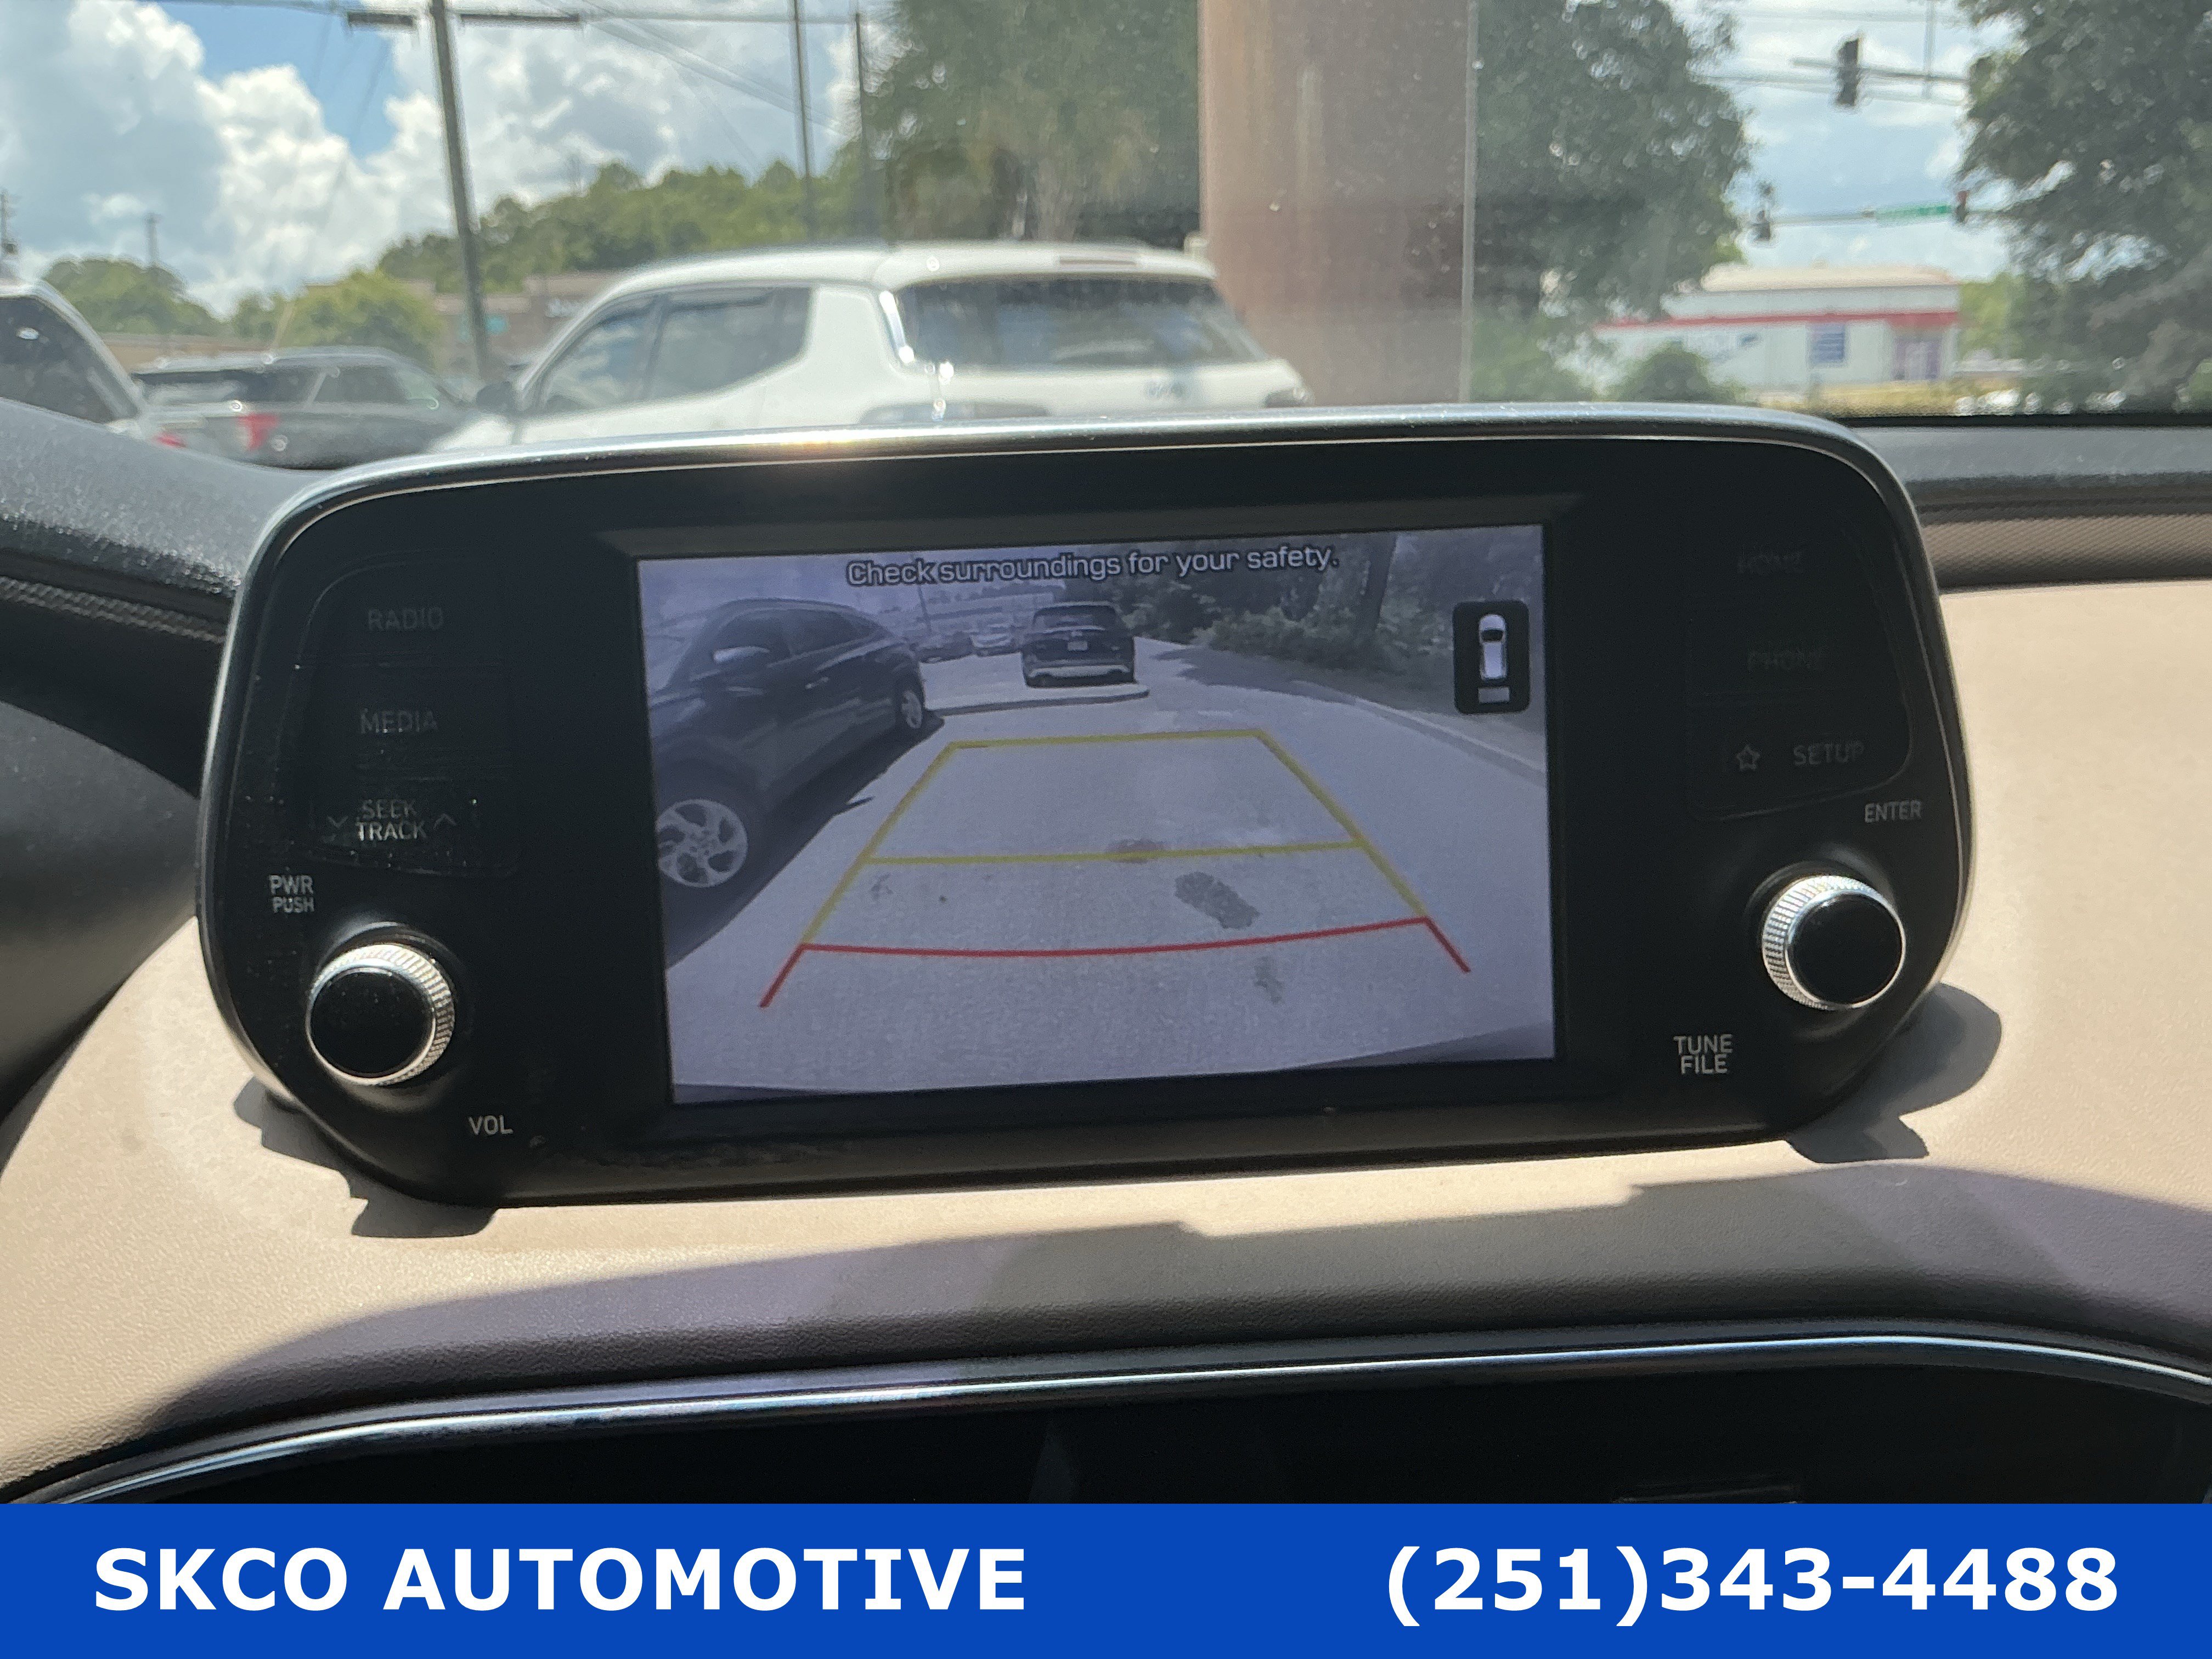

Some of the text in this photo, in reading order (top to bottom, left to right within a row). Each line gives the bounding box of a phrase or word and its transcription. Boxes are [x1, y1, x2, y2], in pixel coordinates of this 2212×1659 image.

[847, 547, 1338, 586] Check surroundings for your safety.
[368, 608, 444, 631] RADIO
[360, 709, 438, 735] MEDIA
[1793, 742, 1865, 766] SETUP
[361, 799, 417, 820] SEEK
[1864, 800, 1922, 823] ENTER
[356, 821, 427, 842] TRACK
[269, 874, 314, 895] PWR
[273, 896, 314, 913] PUSH
[1673, 1035, 1733, 1054] TUNE
[1680, 1054, 1728, 1074] FILE
[469, 1115, 514, 1135] VOL
